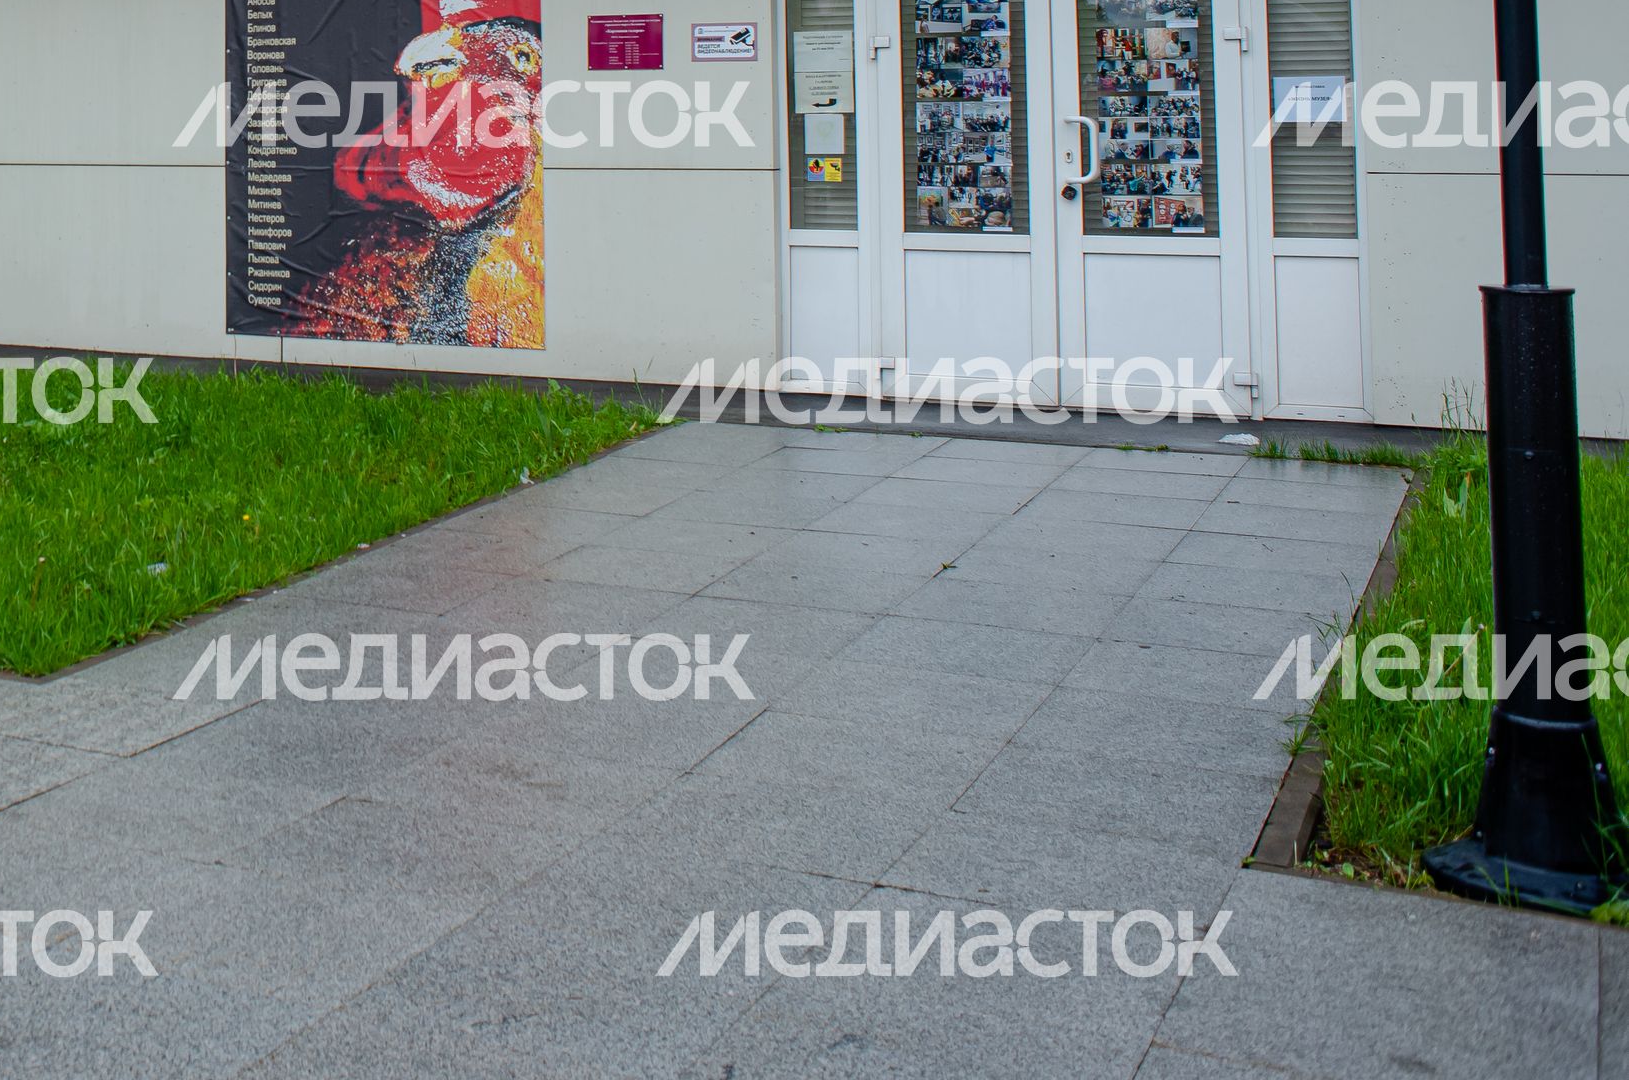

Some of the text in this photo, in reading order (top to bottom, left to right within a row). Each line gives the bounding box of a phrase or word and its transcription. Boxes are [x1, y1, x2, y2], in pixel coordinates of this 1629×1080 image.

[247, 10, 273, 19] Белых
[247, 24, 276, 32] Блинов
[247, 37, 296, 47] Бранковская
[247, 51, 285, 60] Воронова
[247, 64, 284, 74] Головань
[247, 78, 287, 87] Григорьев
[248, 146, 297, 156] Кондратенко
[248, 159, 276, 168] Леонов
[248, 173, 291, 182] Медведева
[248, 186, 282, 195] Мизинов
[248, 213, 285, 223] Нестеров
[248, 226, 292, 236] Никифоров
[248, 240, 286, 250] Павлович
[248, 267, 290, 278] Ржанников
[248, 281, 282, 291] Сидорин
[248, 294, 281, 305] Суворов
